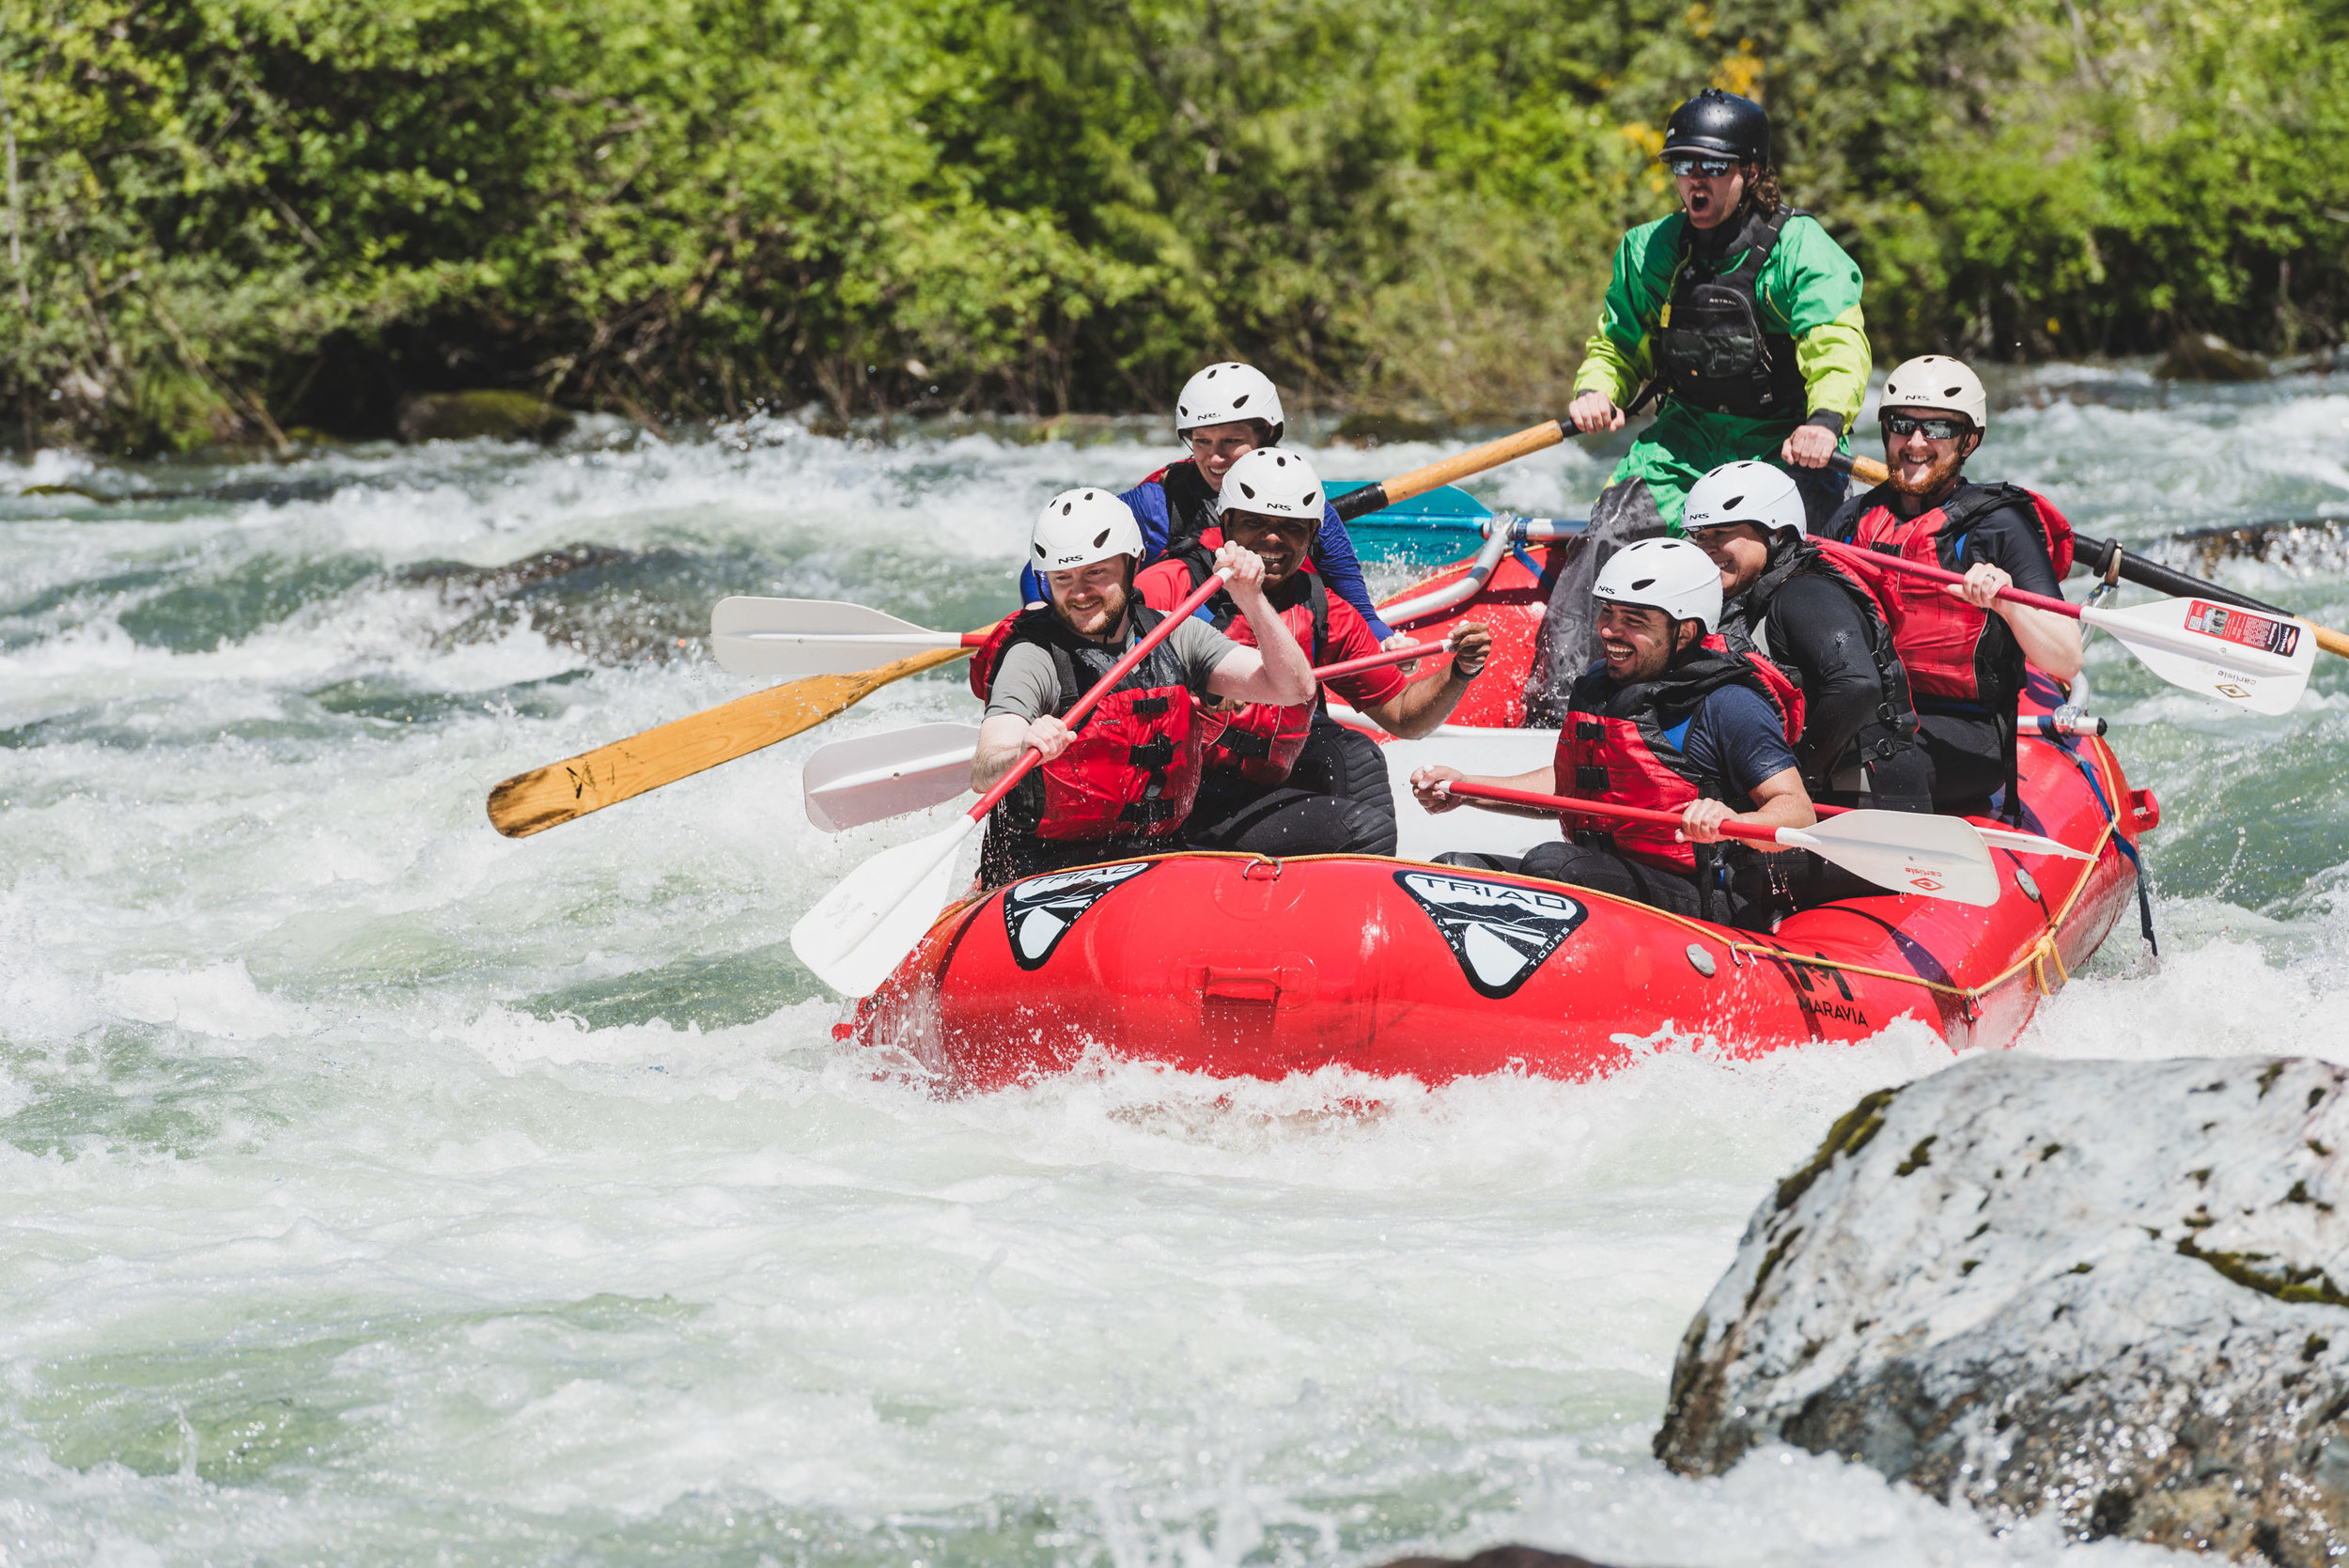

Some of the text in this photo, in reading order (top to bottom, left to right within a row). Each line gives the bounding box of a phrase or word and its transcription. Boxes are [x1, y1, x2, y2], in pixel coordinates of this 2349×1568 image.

[1267, 503, 1292, 511] NRS
[1058, 555, 1082, 564] NRS
[1032, 864, 1143, 886] TRIAD
[1412, 876, 1567, 910] TRIAD
[1004, 903, 1016, 938] RIVER
[1422, 903, 1459, 951] RIVER
[1530, 926, 1570, 967] TOURS
[1796, 993, 1869, 1028] MARAVIA
